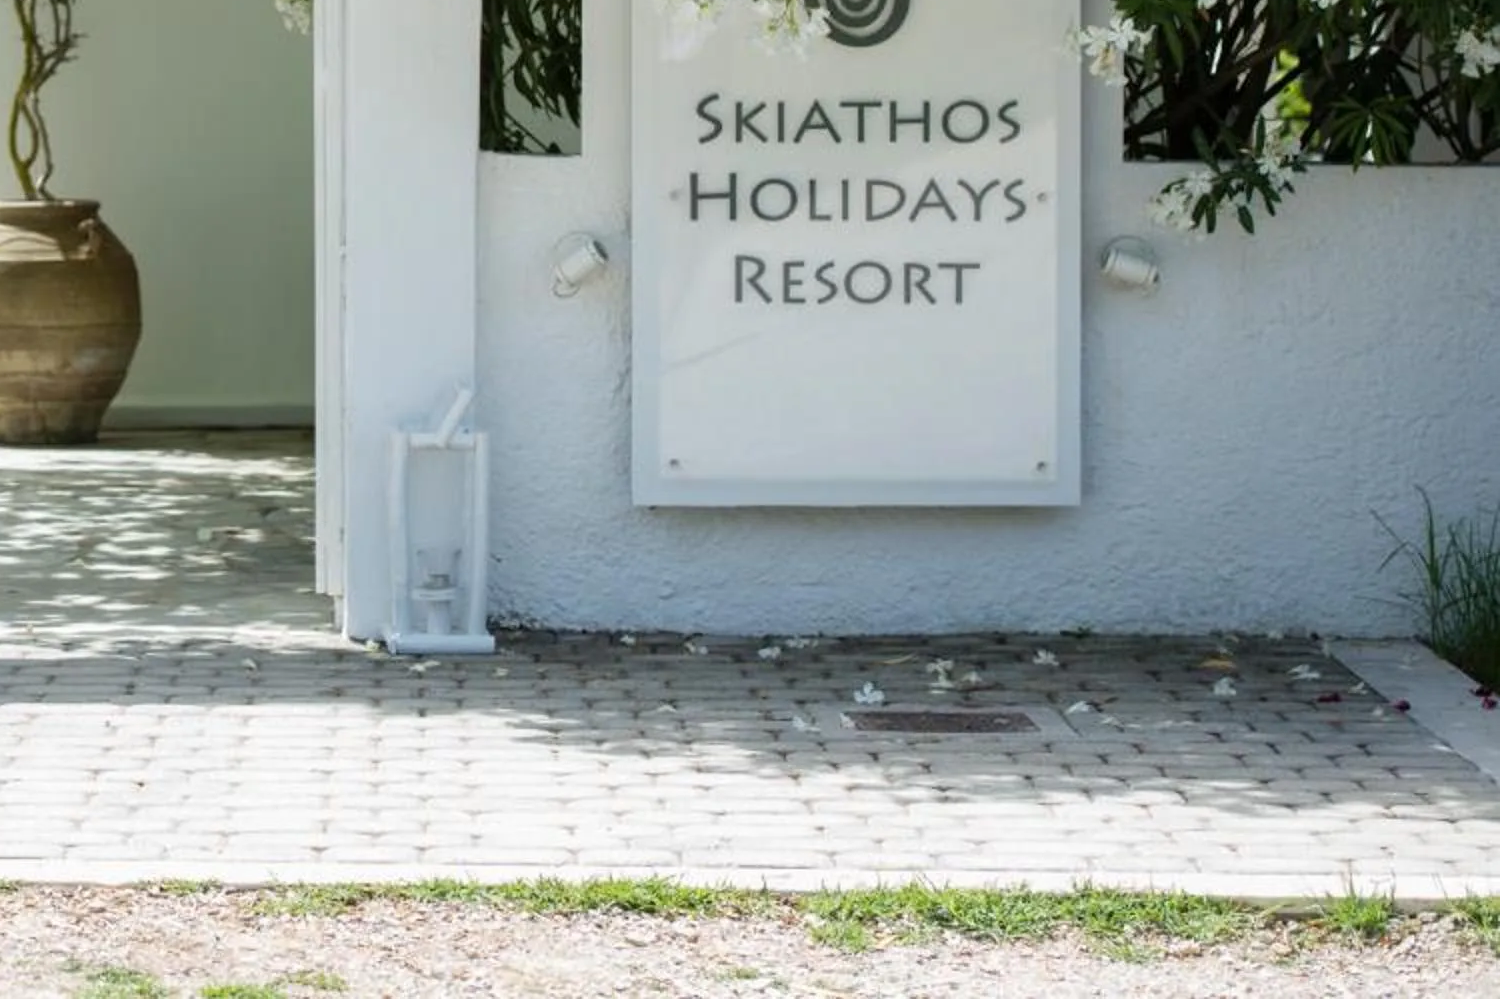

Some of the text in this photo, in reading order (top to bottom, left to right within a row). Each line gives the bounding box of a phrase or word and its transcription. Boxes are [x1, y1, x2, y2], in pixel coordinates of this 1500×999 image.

[694, 92, 1022, 144] SKIATHOS
[688, 171, 1027, 223] HOLIDAYS
[733, 254, 981, 305] RESORT
